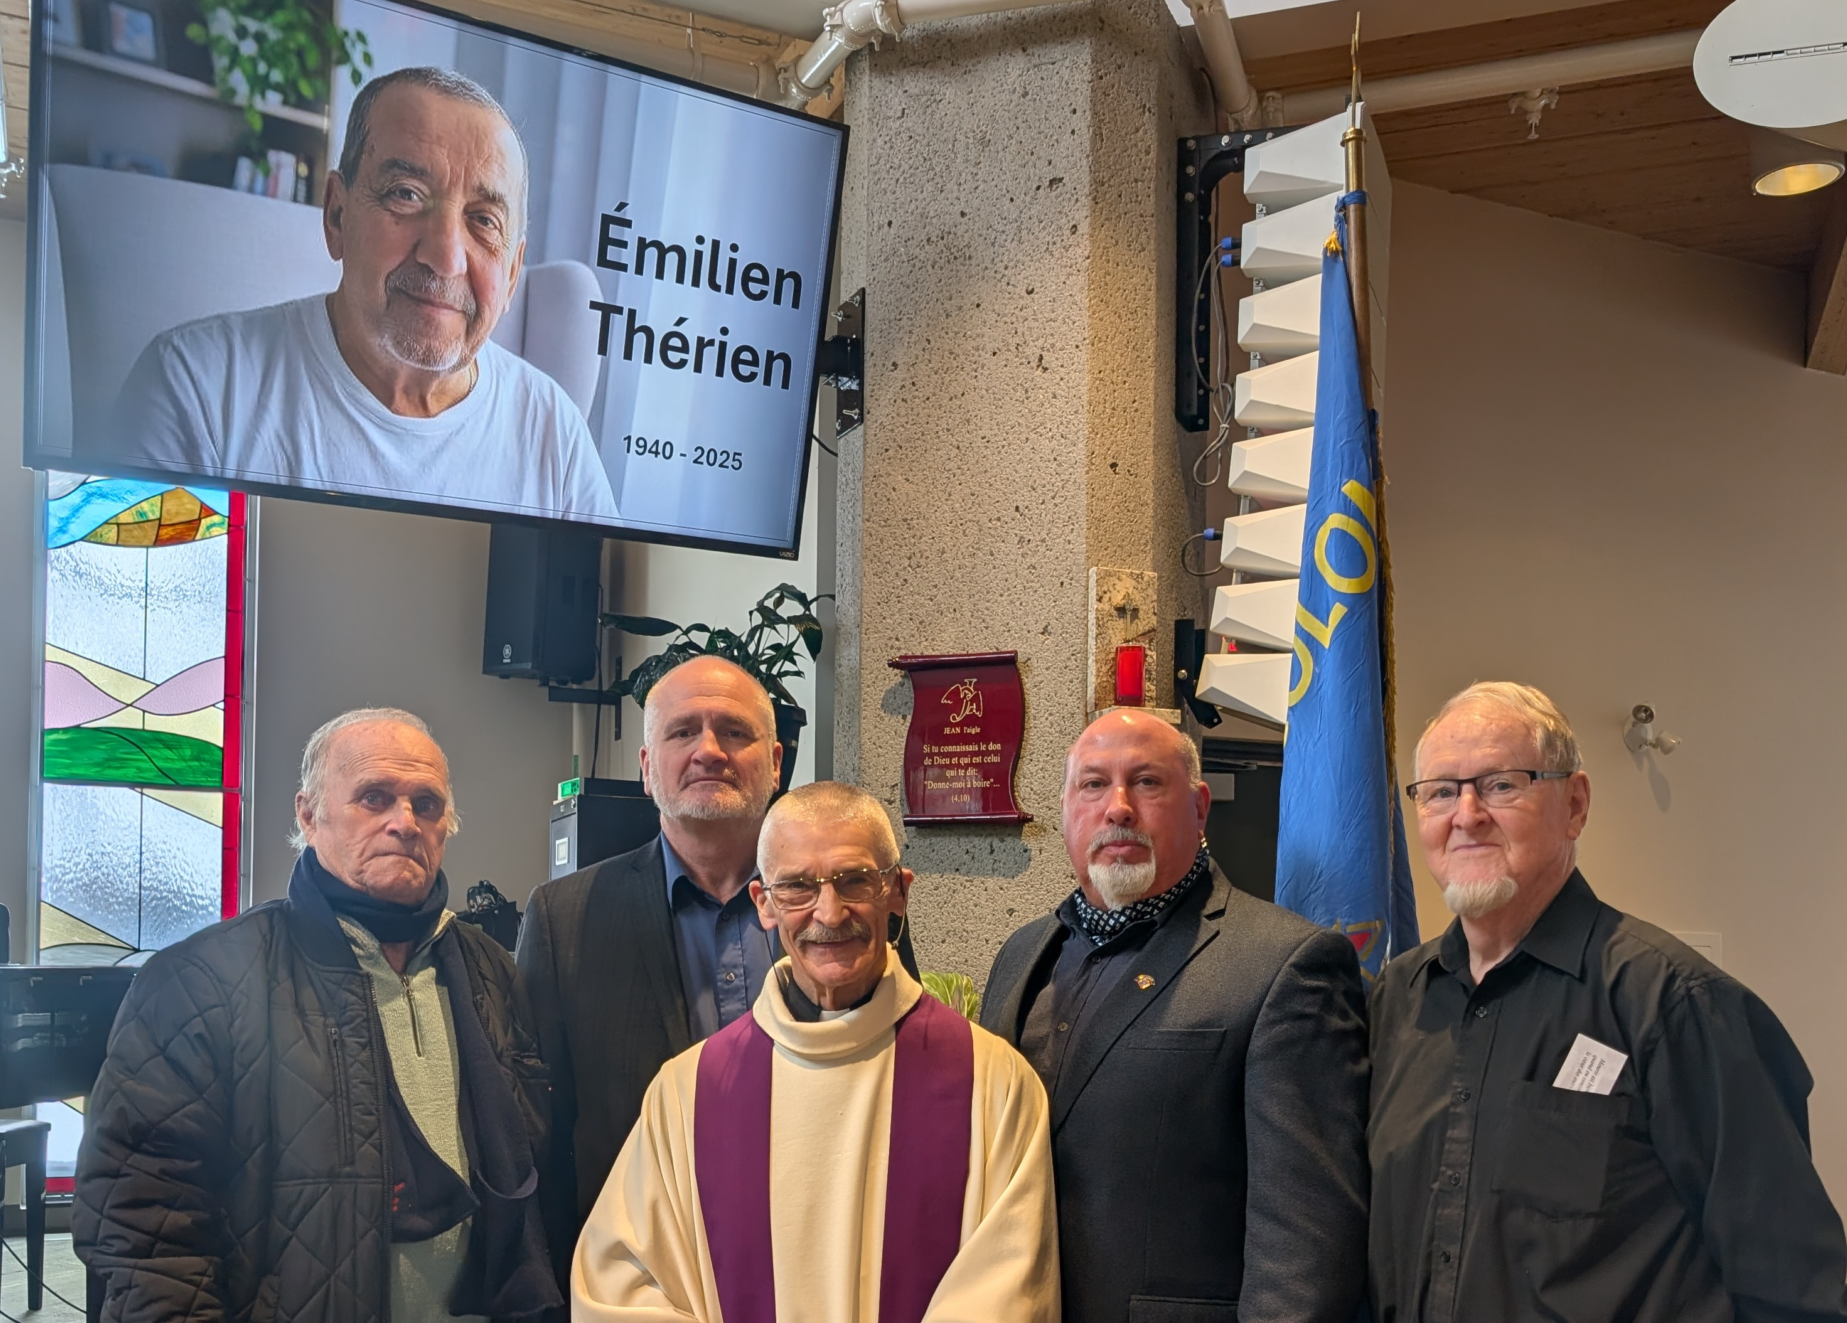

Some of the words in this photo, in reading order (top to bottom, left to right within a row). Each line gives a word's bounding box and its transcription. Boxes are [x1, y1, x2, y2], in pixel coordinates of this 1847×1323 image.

[596, 201, 802, 310] Émilien
[589, 300, 792, 390] Thérien
[622, 435, 674, 460] 1940
[692, 446, 743, 471] 2025
[943, 727, 961, 735] JEAN
[923, 744, 930, 753] Si
[932, 745, 939, 753] tu
[940, 743, 979, 752] connaissais
[980, 742, 986, 751] le
[988, 741, 1002, 751] don
[924, 756, 932, 765] de
[934, 756, 950, 765] Dieu
[952, 756, 958, 764] et
[959, 755, 971, 766] qui
[972, 755, 982, 764] est
[984, 754, 1000, 763] celui
[946, 768, 957, 778] qui
[958, 768, 965, 776] te
[966, 766, 978, 776] dit:
[966, 779, 971, 788] à
